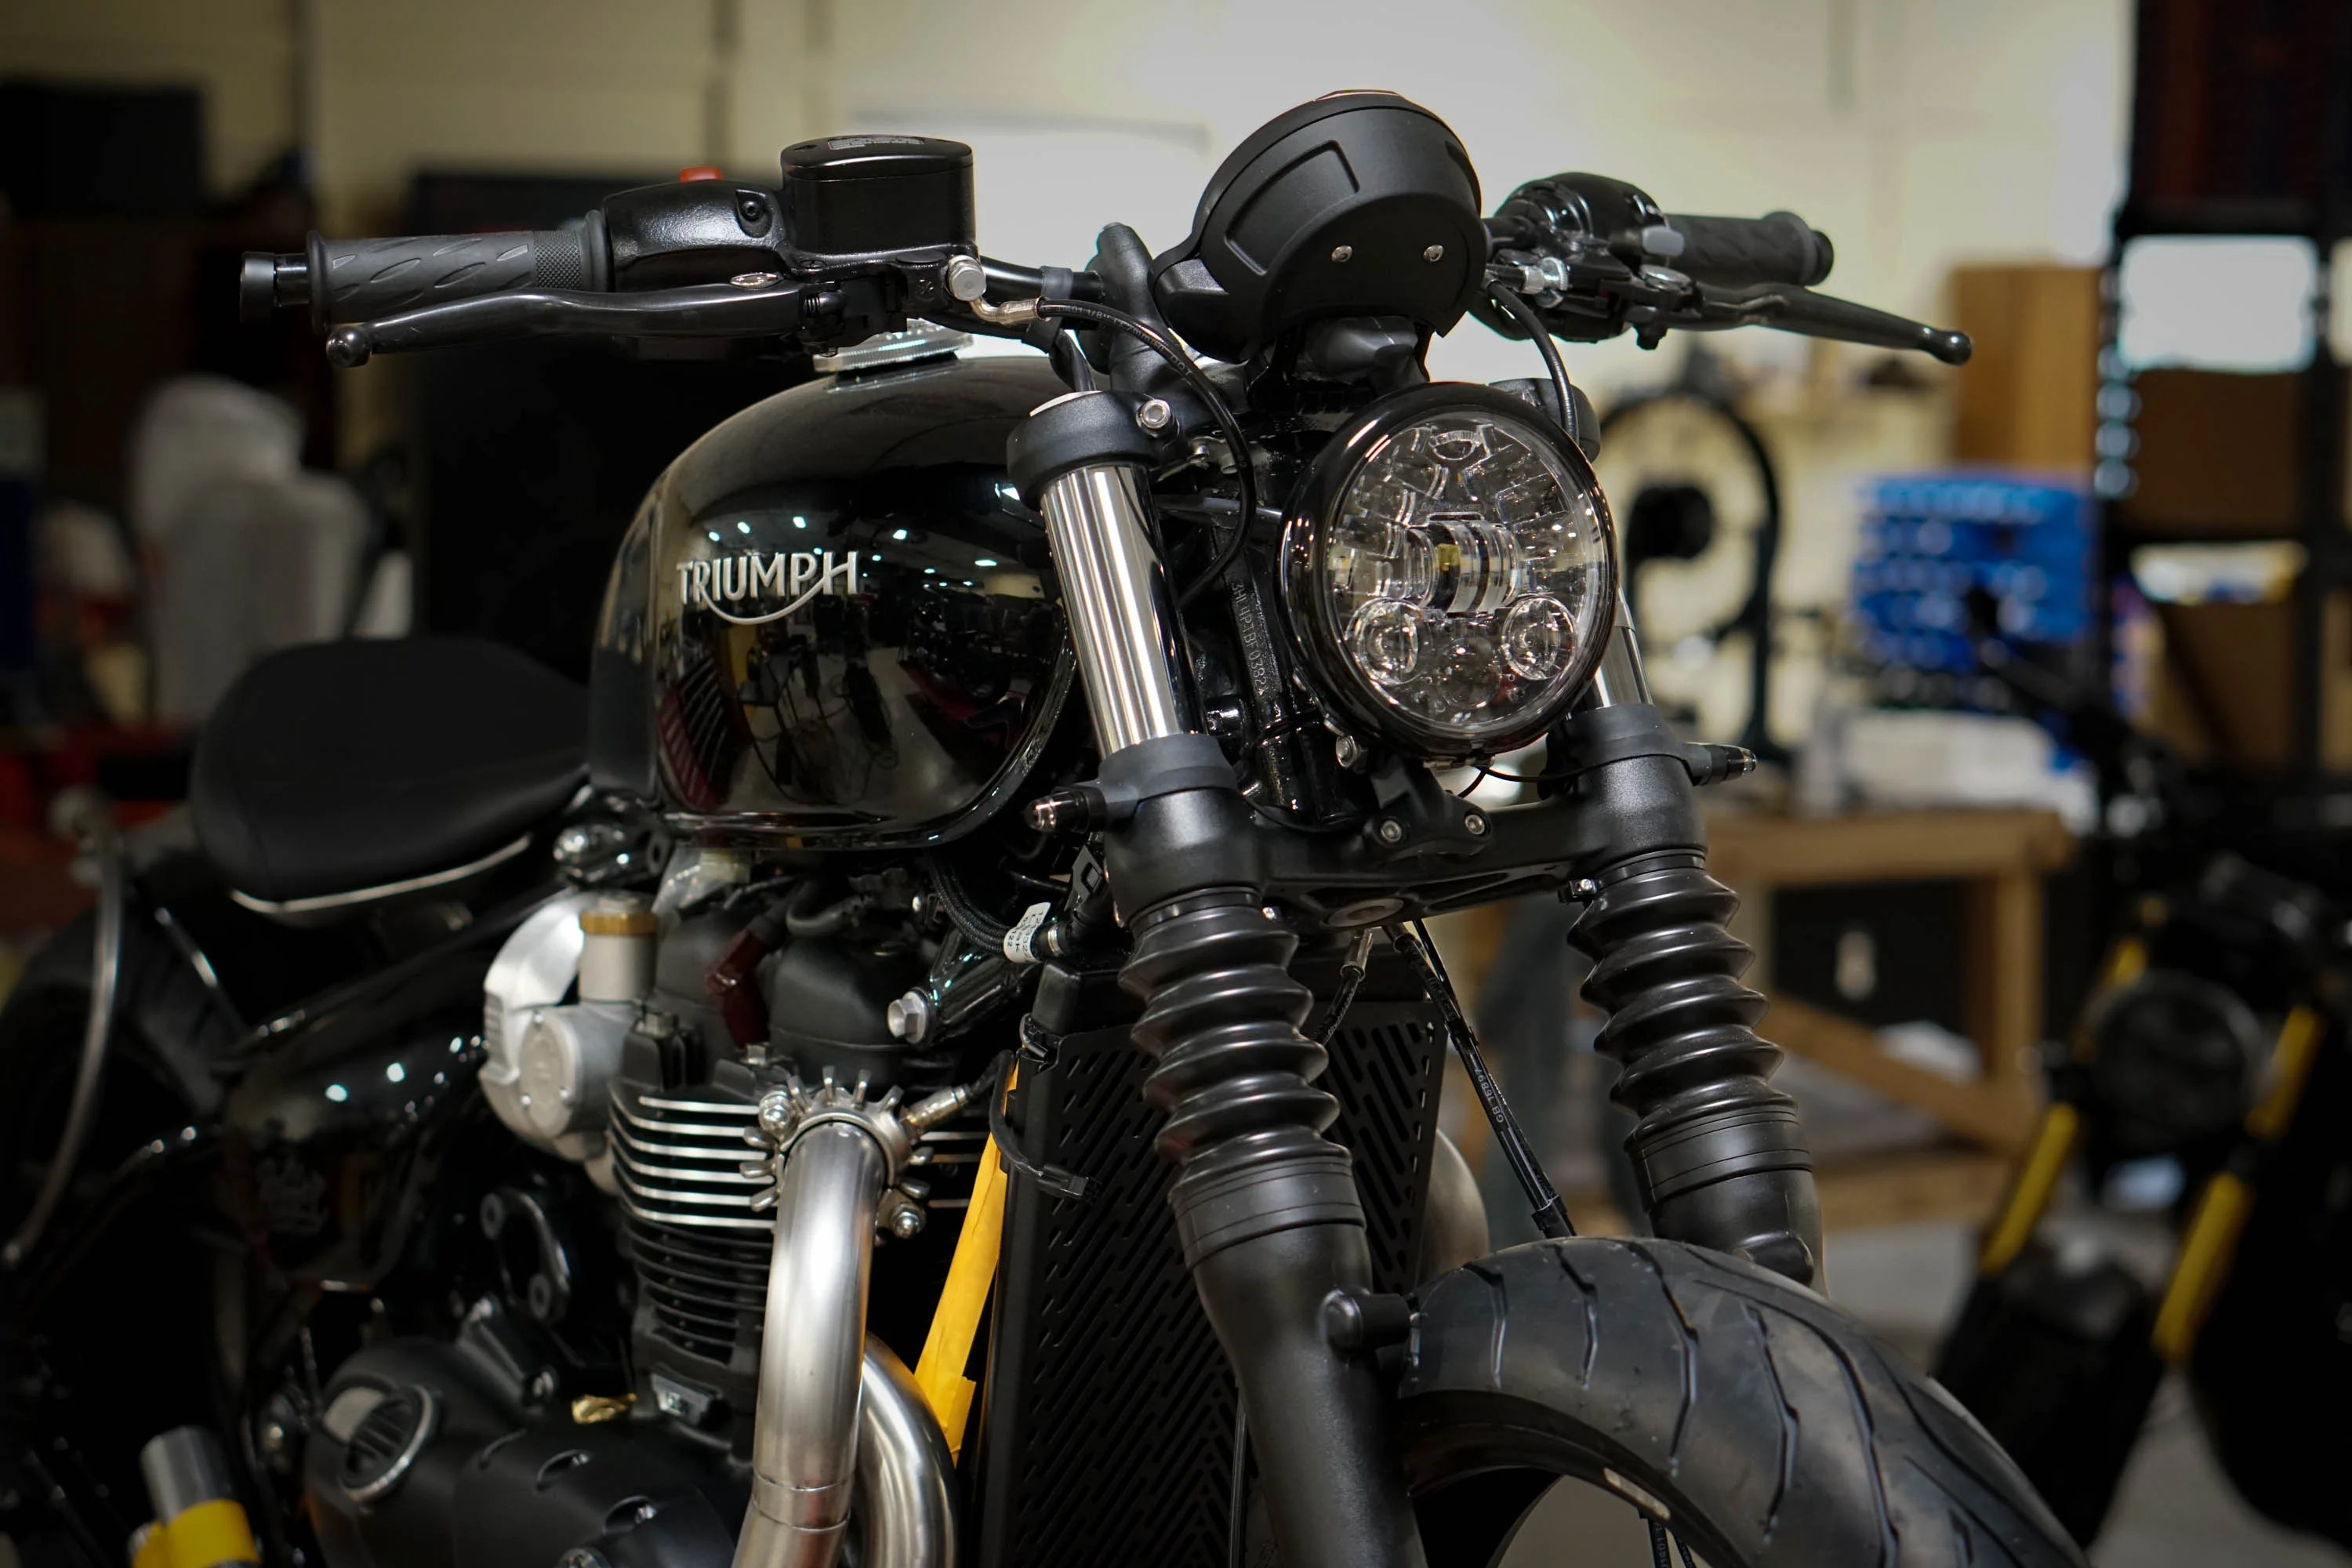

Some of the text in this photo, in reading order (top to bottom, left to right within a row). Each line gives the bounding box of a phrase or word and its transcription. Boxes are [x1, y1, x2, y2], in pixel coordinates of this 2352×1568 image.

[1171, 355, 1192, 376] DOT
[676, 550, 858, 625] TRIUMPH
[1474, 1068, 1494, 1101] 16897
[1492, 1105, 1504, 1123] GB
